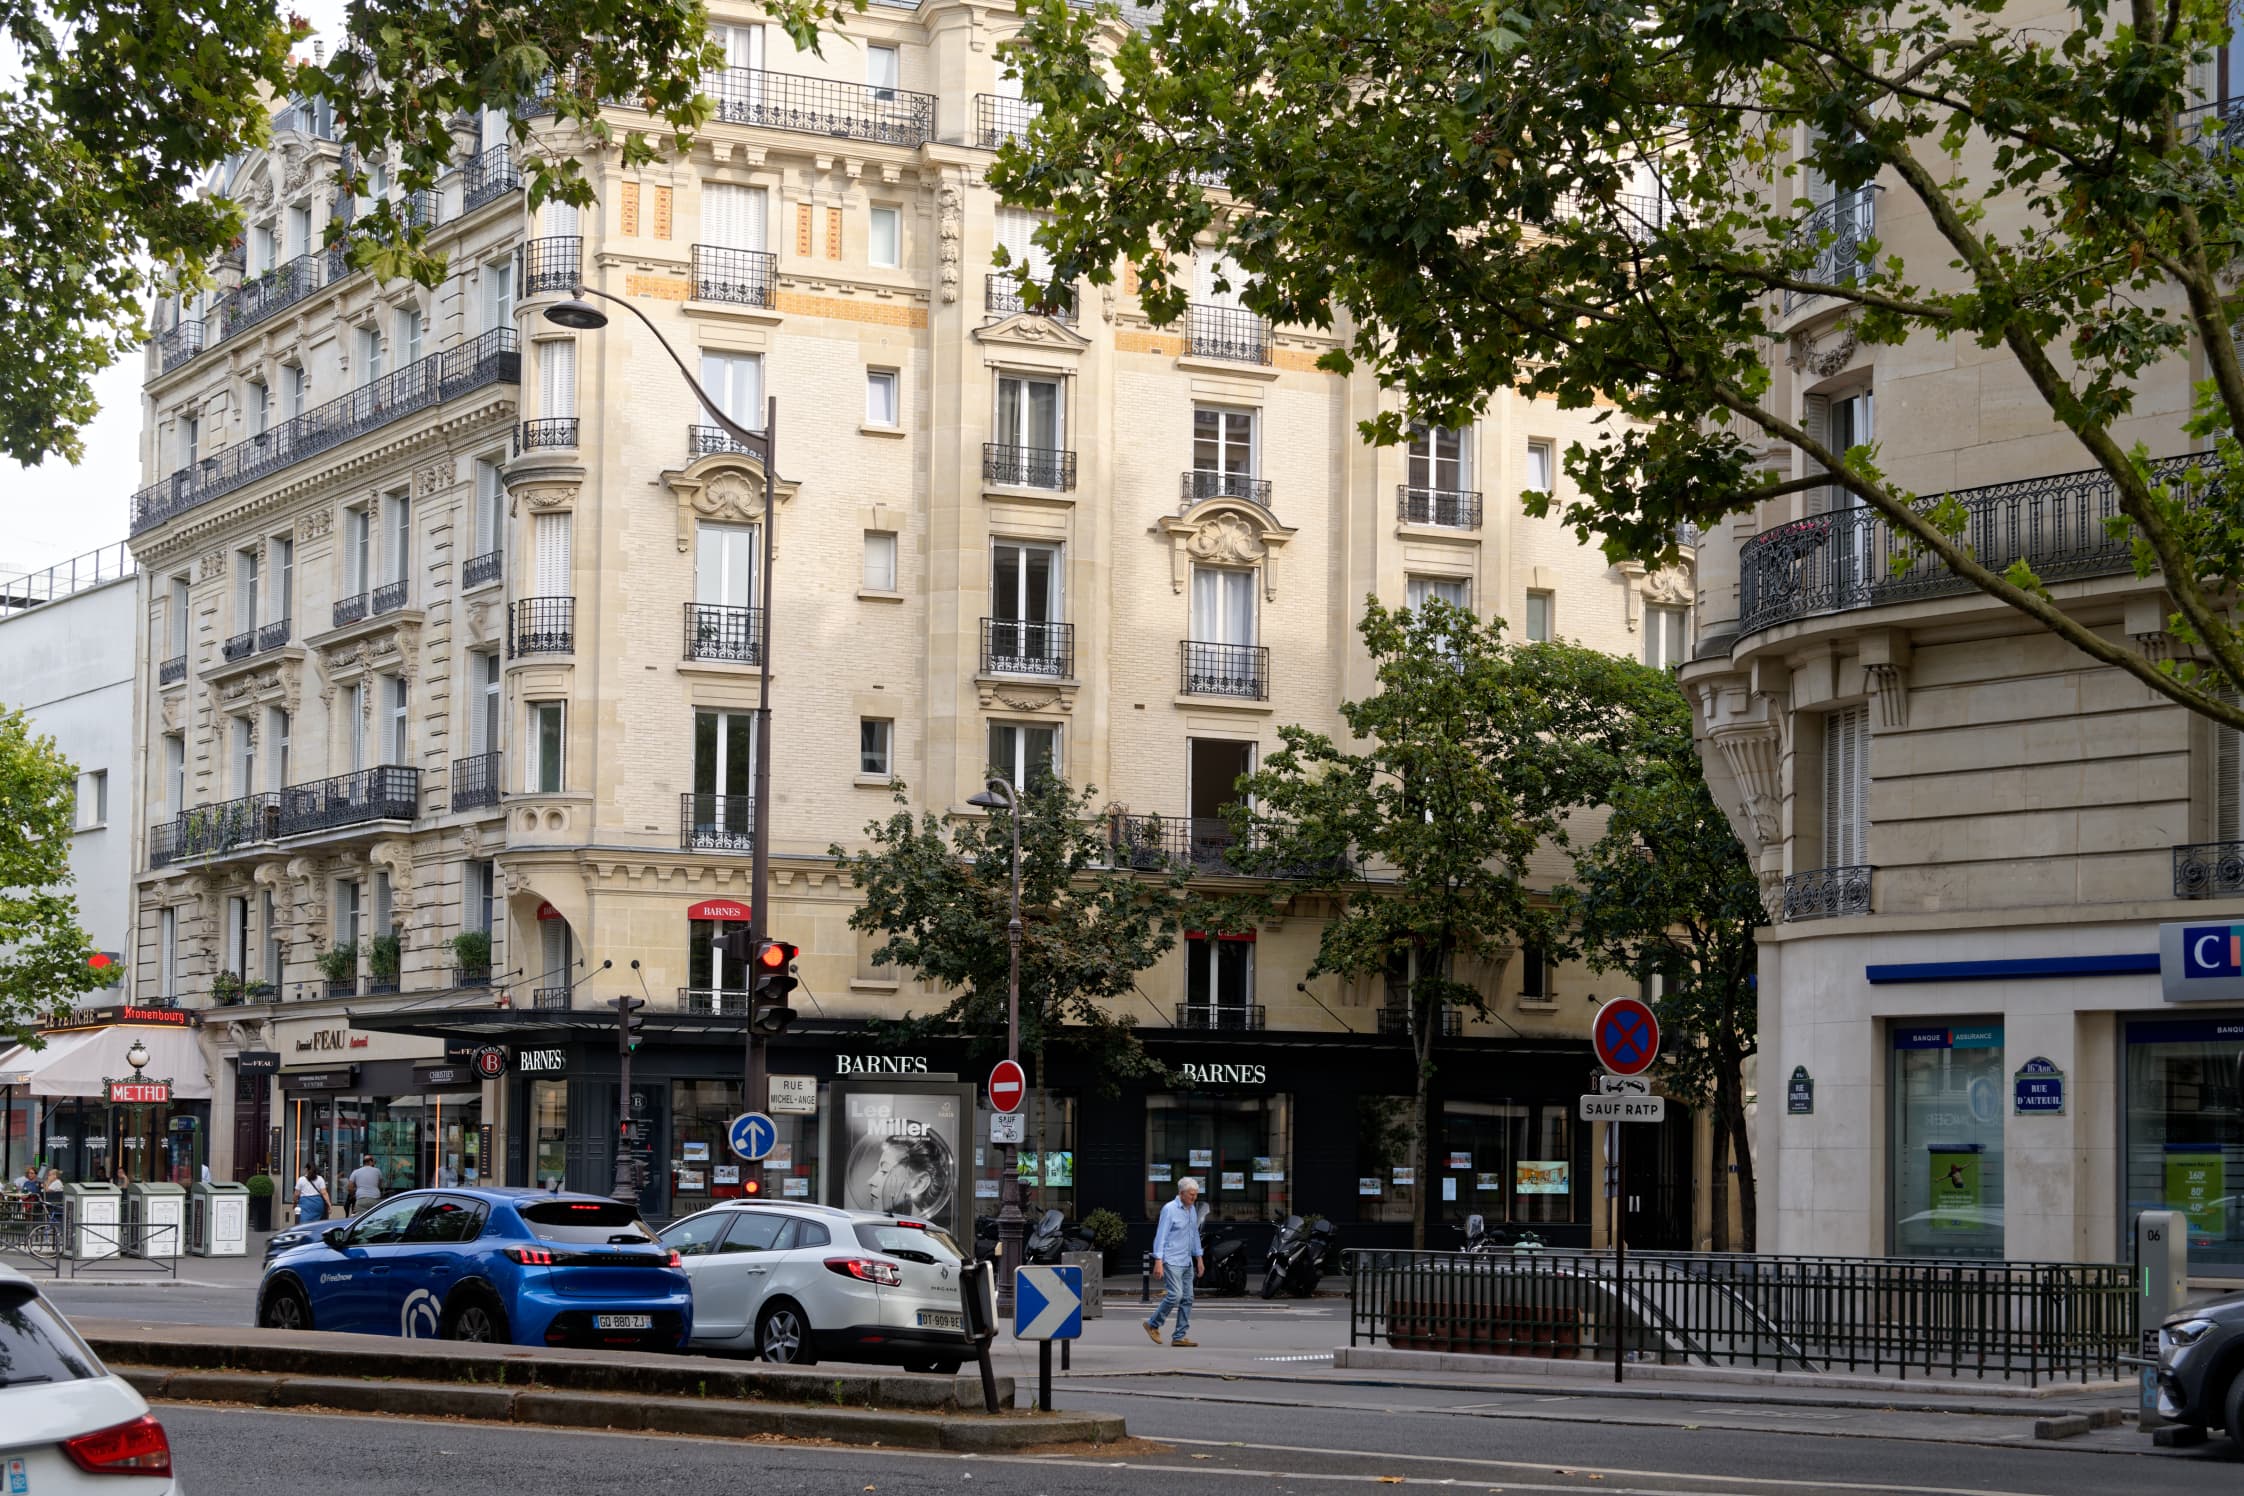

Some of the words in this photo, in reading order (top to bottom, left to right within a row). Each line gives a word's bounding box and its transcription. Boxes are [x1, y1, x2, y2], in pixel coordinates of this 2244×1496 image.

[703, 906, 741, 917] BARNES
[124, 1005, 185, 1024] Kronenbourg
[313, 1029, 347, 1051] FEAU
[1912, 1034, 1941, 1042] BANQUE
[1955, 1032, 1993, 1041] ASSURANCE
[520, 1049, 562, 1071] BARNES
[835, 1054, 928, 1075] BARNES
[1182, 1063, 1267, 1084] BARNES
[784, 1080, 803, 1090] RUE
[2031, 1084, 2048, 1093] RUE
[113, 1085, 166, 1101] METRO
[770, 1094, 816, 1106] MICHEL-ANGE
[2017, 1096, 2062, 1105] D'AUTEUIL
[851, 1101, 891, 1118] Lee
[1586, 1103, 1621, 1115] SAUF
[1625, 1104, 1659, 1116] RATP
[866, 1118, 931, 1137] Miller
[2147, 1230, 2160, 1241] 06
